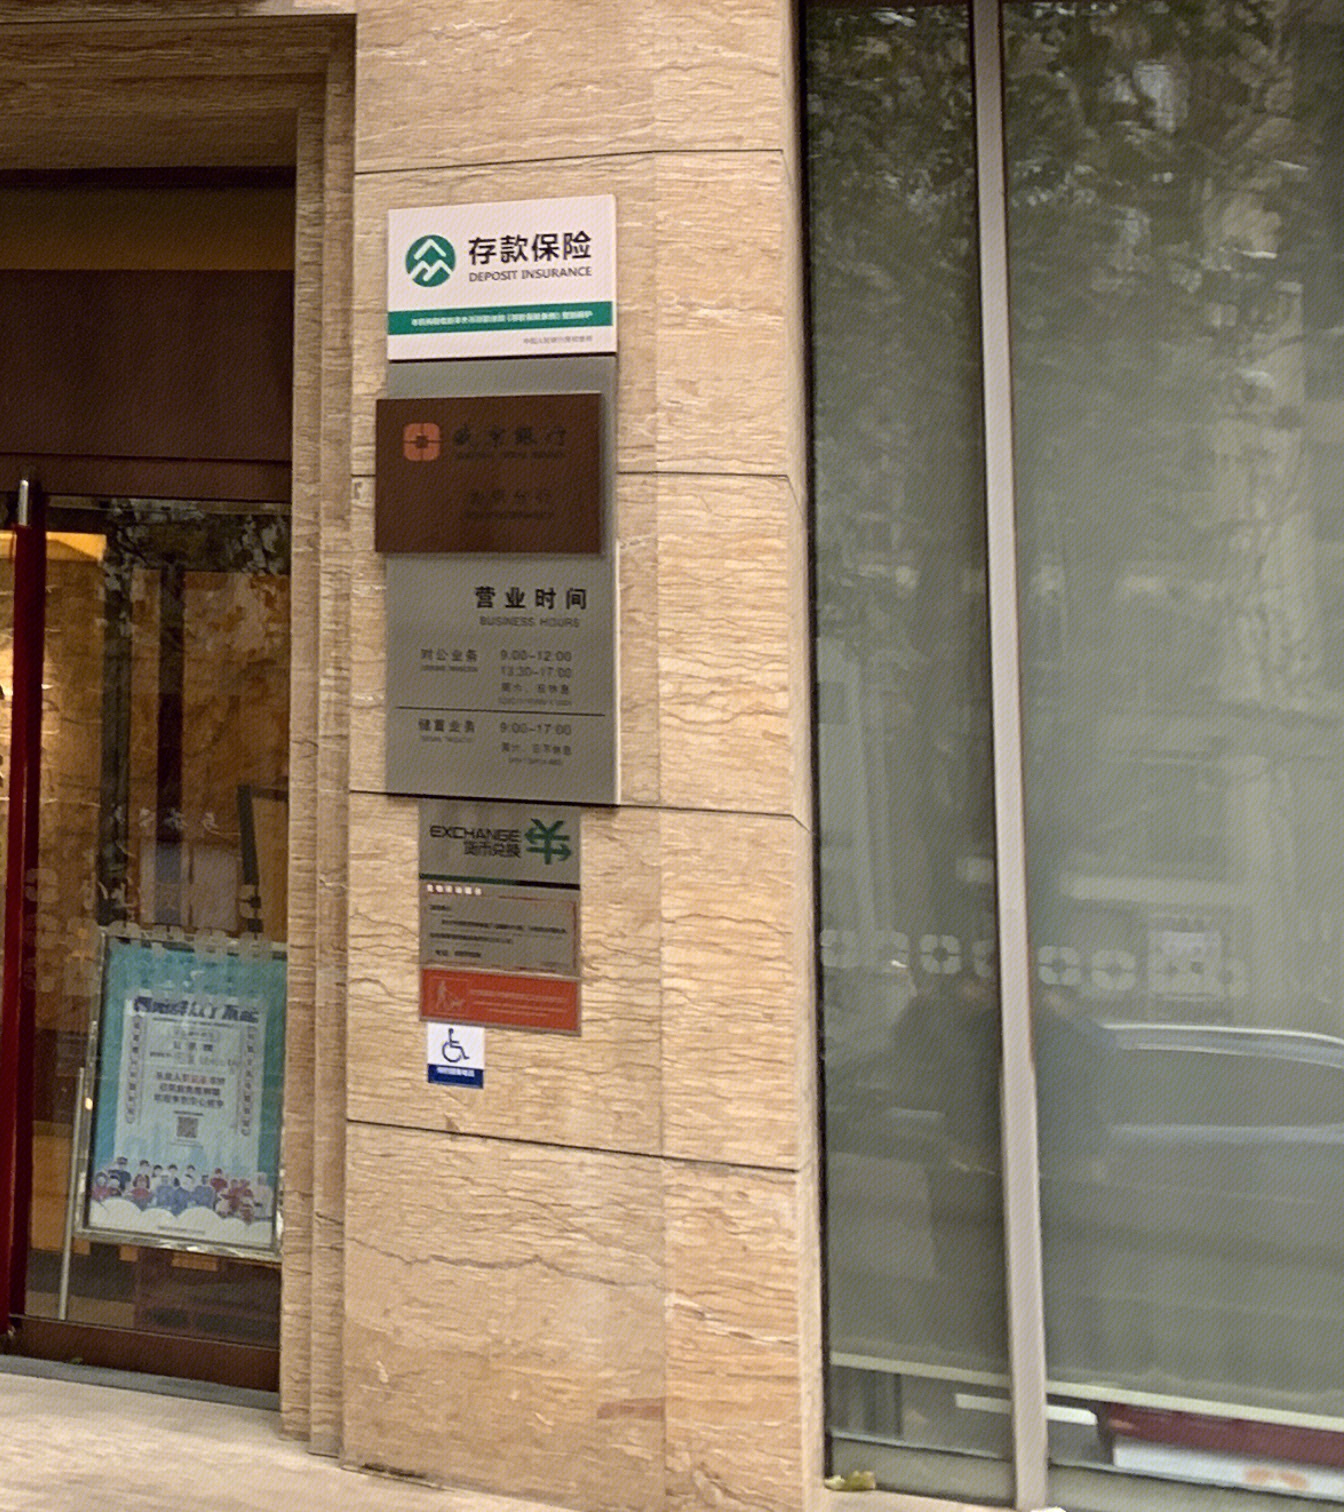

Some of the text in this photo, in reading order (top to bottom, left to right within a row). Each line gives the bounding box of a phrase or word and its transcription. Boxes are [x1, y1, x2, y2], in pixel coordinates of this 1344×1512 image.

[468, 230, 592, 265] 存款保险
[469, 266, 593, 282] DEPOSIT INSURANCE
[474, 586, 587, 609] 营业时间
[479, 616, 580, 627] BUSINESS HOURS
[429, 825, 521, 842] EXCHANGE
